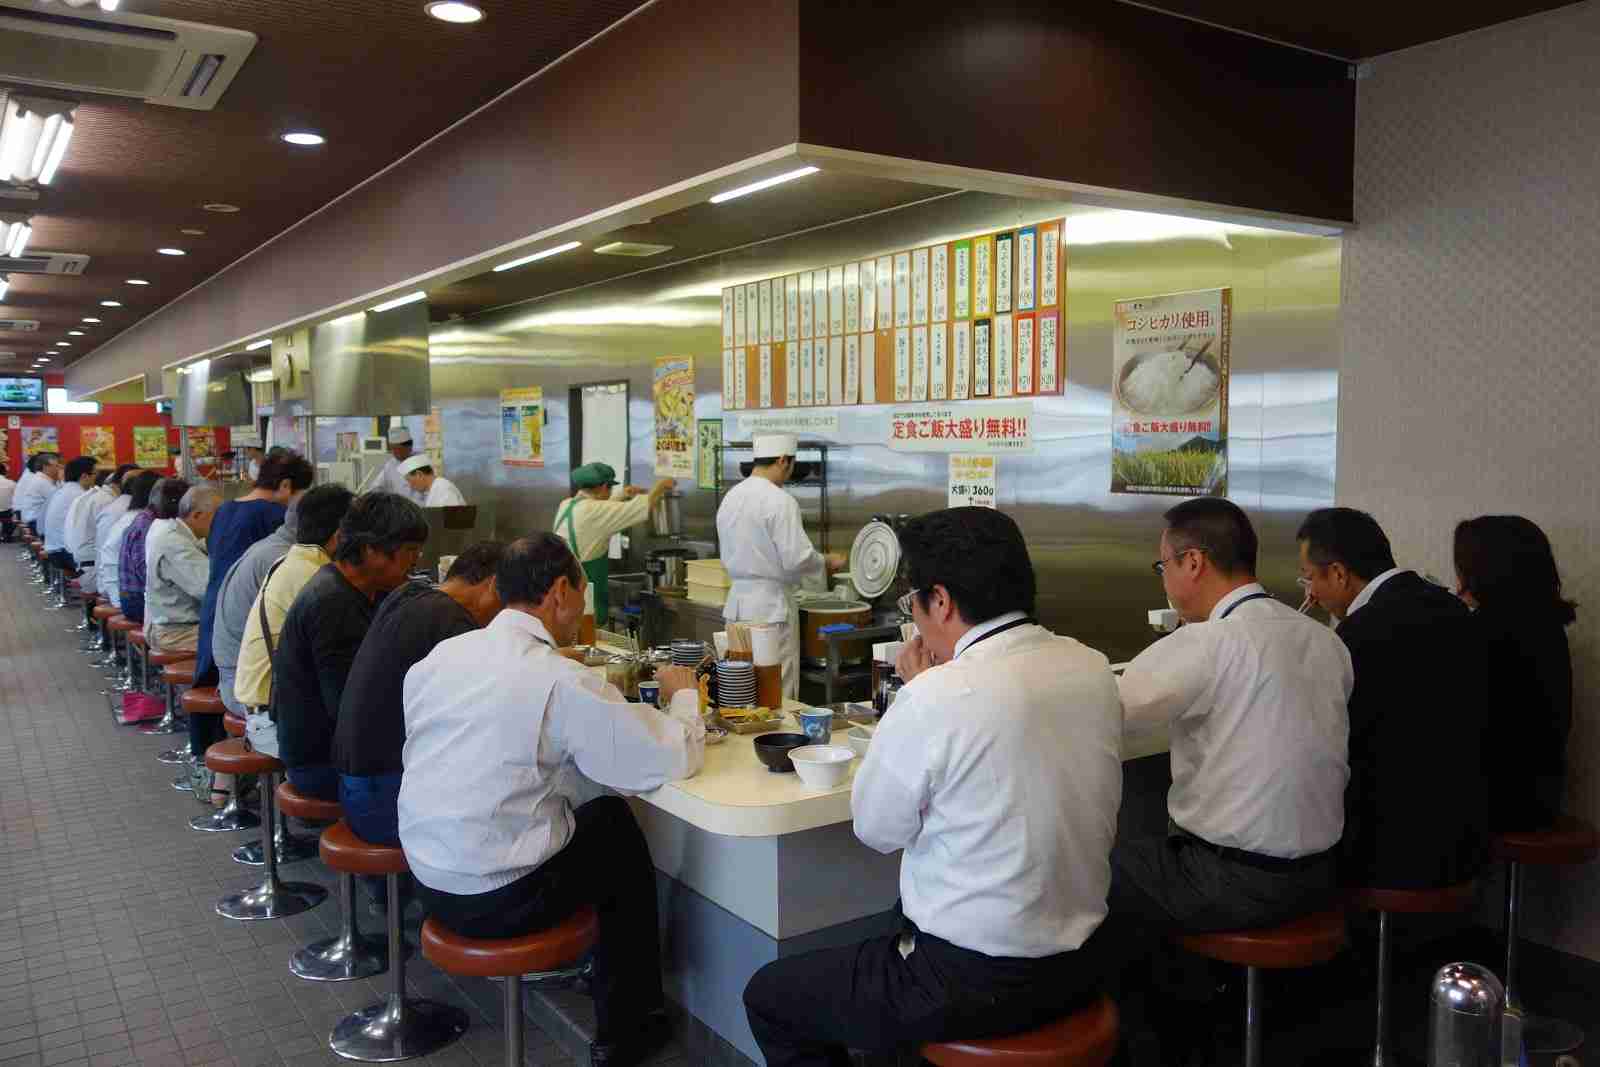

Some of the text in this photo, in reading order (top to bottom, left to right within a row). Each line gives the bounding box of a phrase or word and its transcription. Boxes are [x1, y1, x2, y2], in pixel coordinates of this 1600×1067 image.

[892, 417, 1027, 440] 定食ご飯大盛り無料!!
